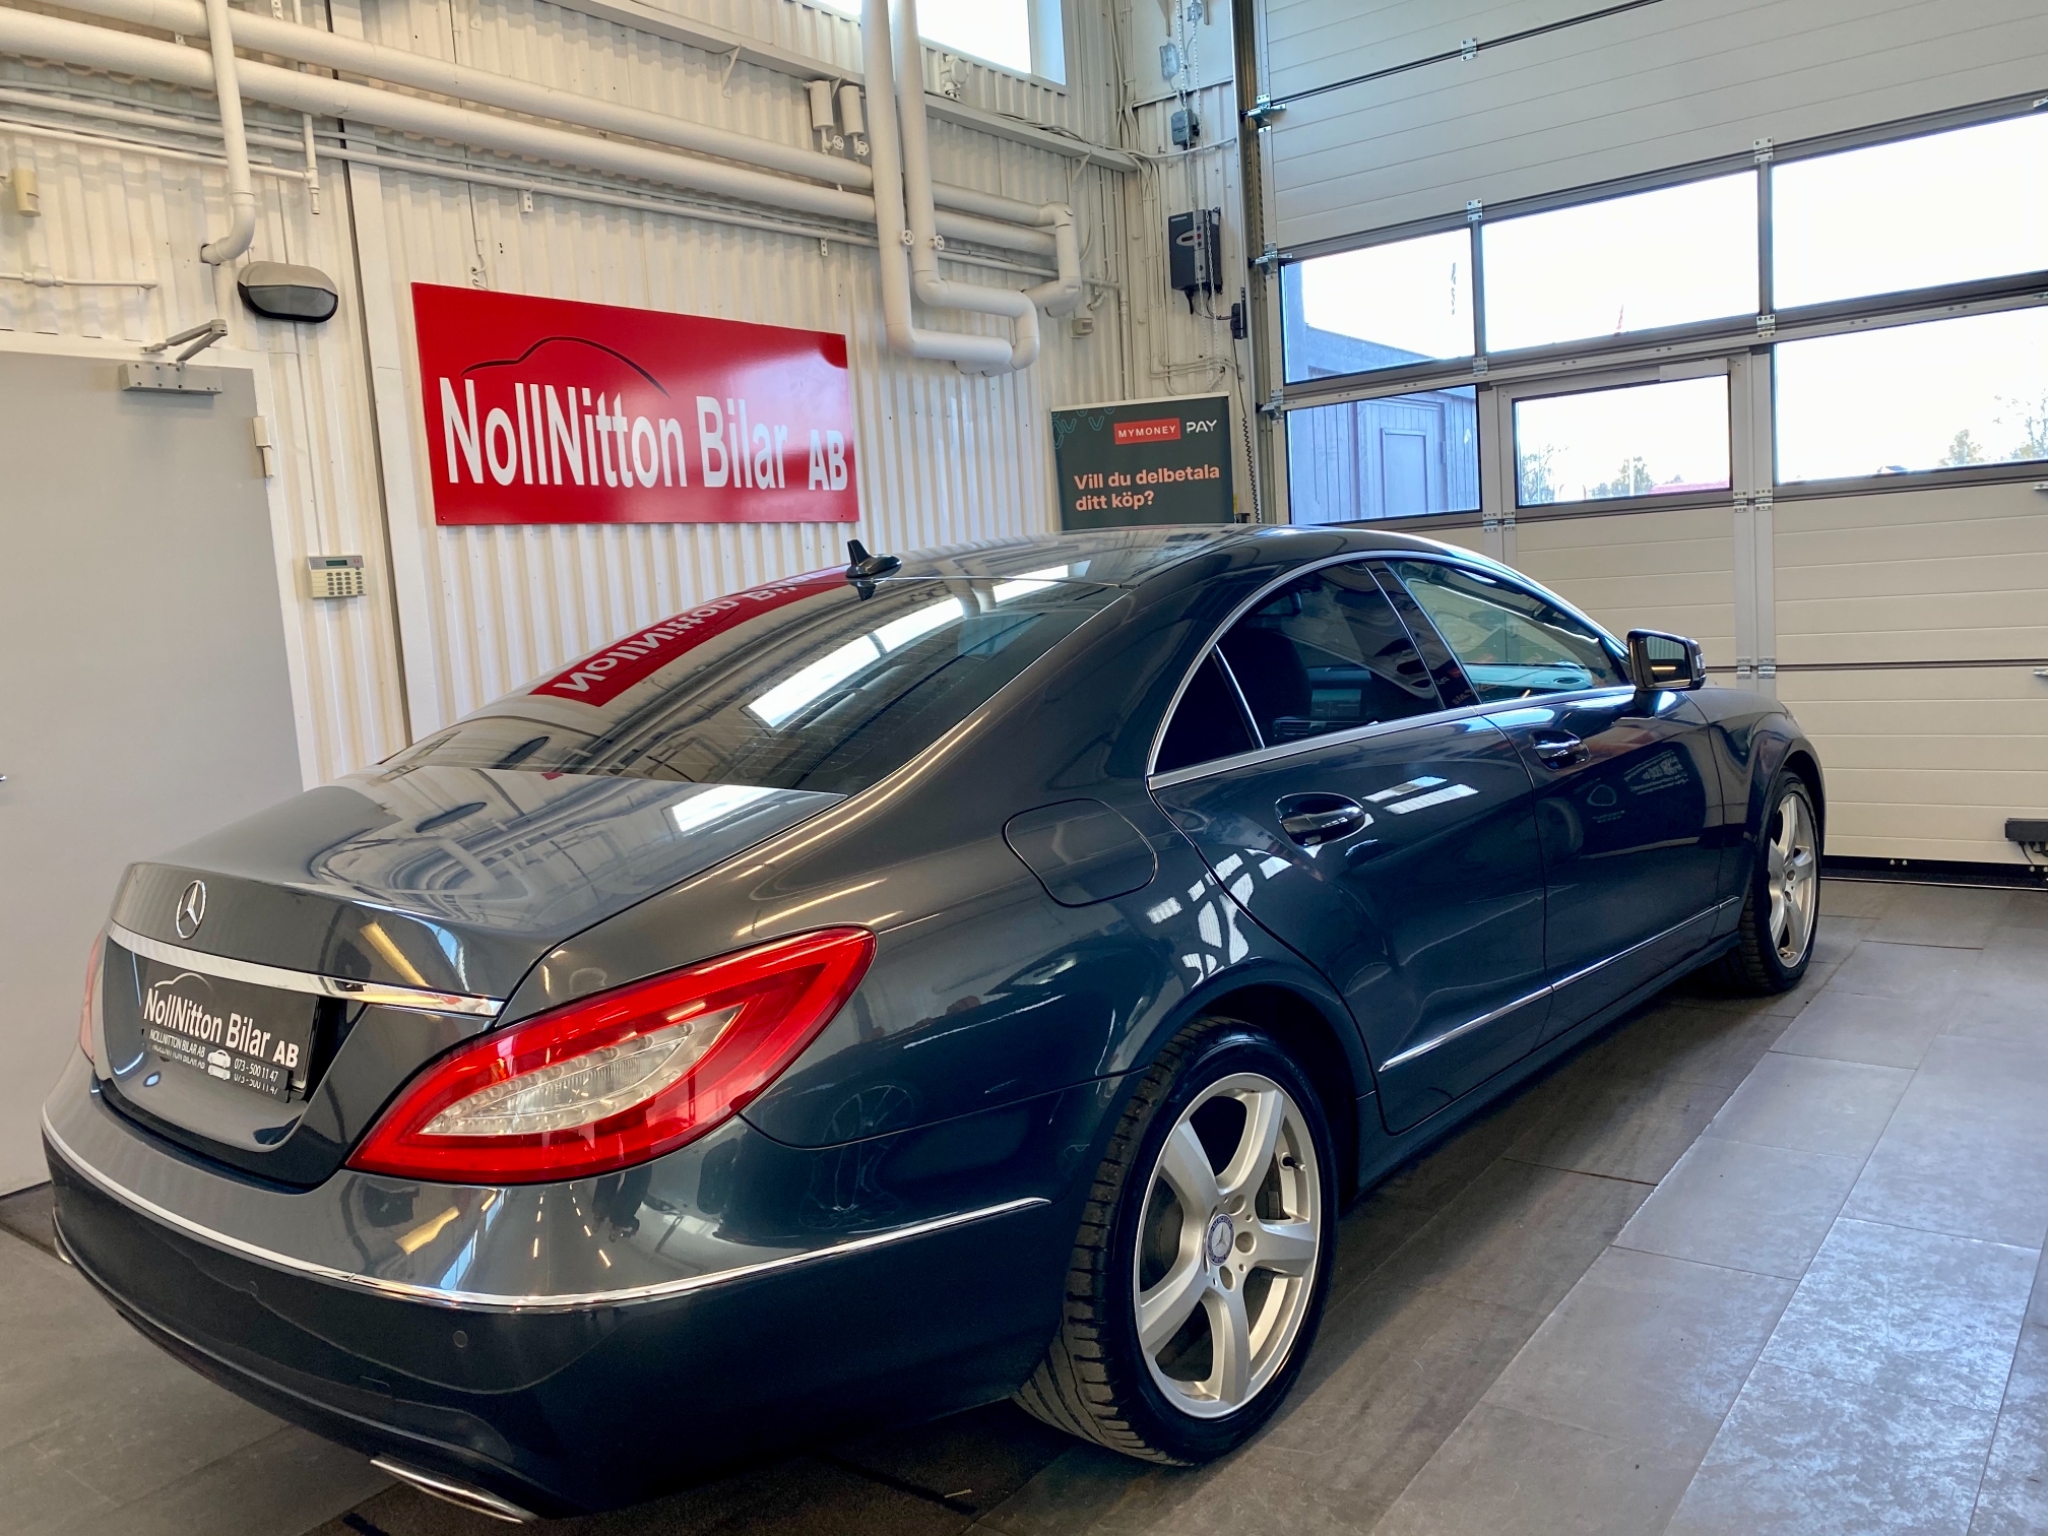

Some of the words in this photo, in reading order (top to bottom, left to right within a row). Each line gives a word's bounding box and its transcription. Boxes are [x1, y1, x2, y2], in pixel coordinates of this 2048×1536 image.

[439, 377, 688, 488] NollNitton
[696, 396, 787, 490] Bilar
[808, 428, 848, 491] AB
[1118, 425, 1177, 438] MYMONEY
[1186, 419, 1218, 434] PAY
[1073, 472, 1104, 490] Vill
[1107, 471, 1132, 488] du
[1135, 464, 1220, 485] delbetala
[1075, 495, 1108, 511] ditt
[1111, 490, 1155, 510] köp?
[143, 988, 223, 1044] NollNitton
[225, 1012, 271, 1059] Bilar
[272, 1040, 299, 1068] AB
[182, 1039, 198, 1056] BILAR
[197, 1046, 206, 1058] AB
[234, 1058, 246, 1072] 073
[248, 1063, 262, 1077] 500
[261, 1067, 270, 1080] 11
[269, 1070, 279, 1083] 47
